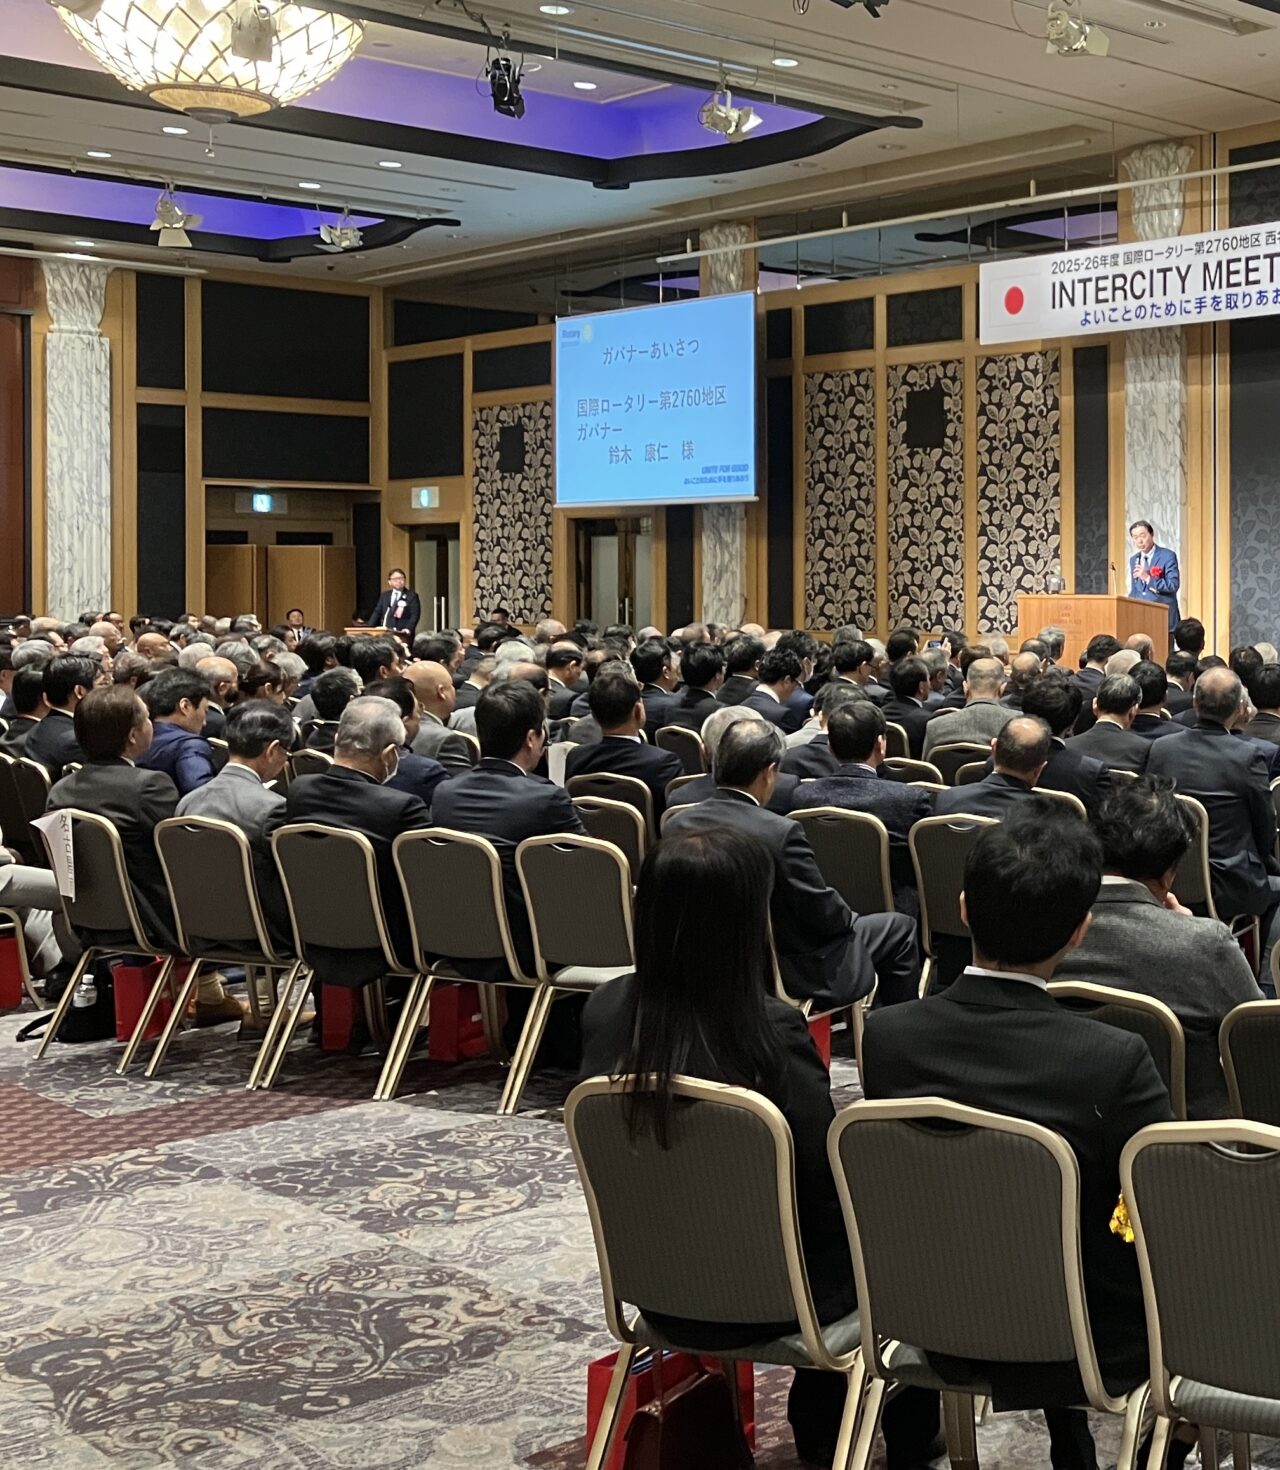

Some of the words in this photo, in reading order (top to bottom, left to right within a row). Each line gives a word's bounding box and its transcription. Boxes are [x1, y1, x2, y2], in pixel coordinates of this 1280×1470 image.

[1051, 254, 1120, 275] 2025-26年度
[1123, 232, 1261, 265] 国際ロータリー第2760地区
[1051, 263, 1193, 310] INTERCITY
[602, 337, 700, 365] ガバナーあいさつ
[576, 385, 728, 418] 国際ロータリー第2760地区
[577, 421, 623, 441] ガバナー
